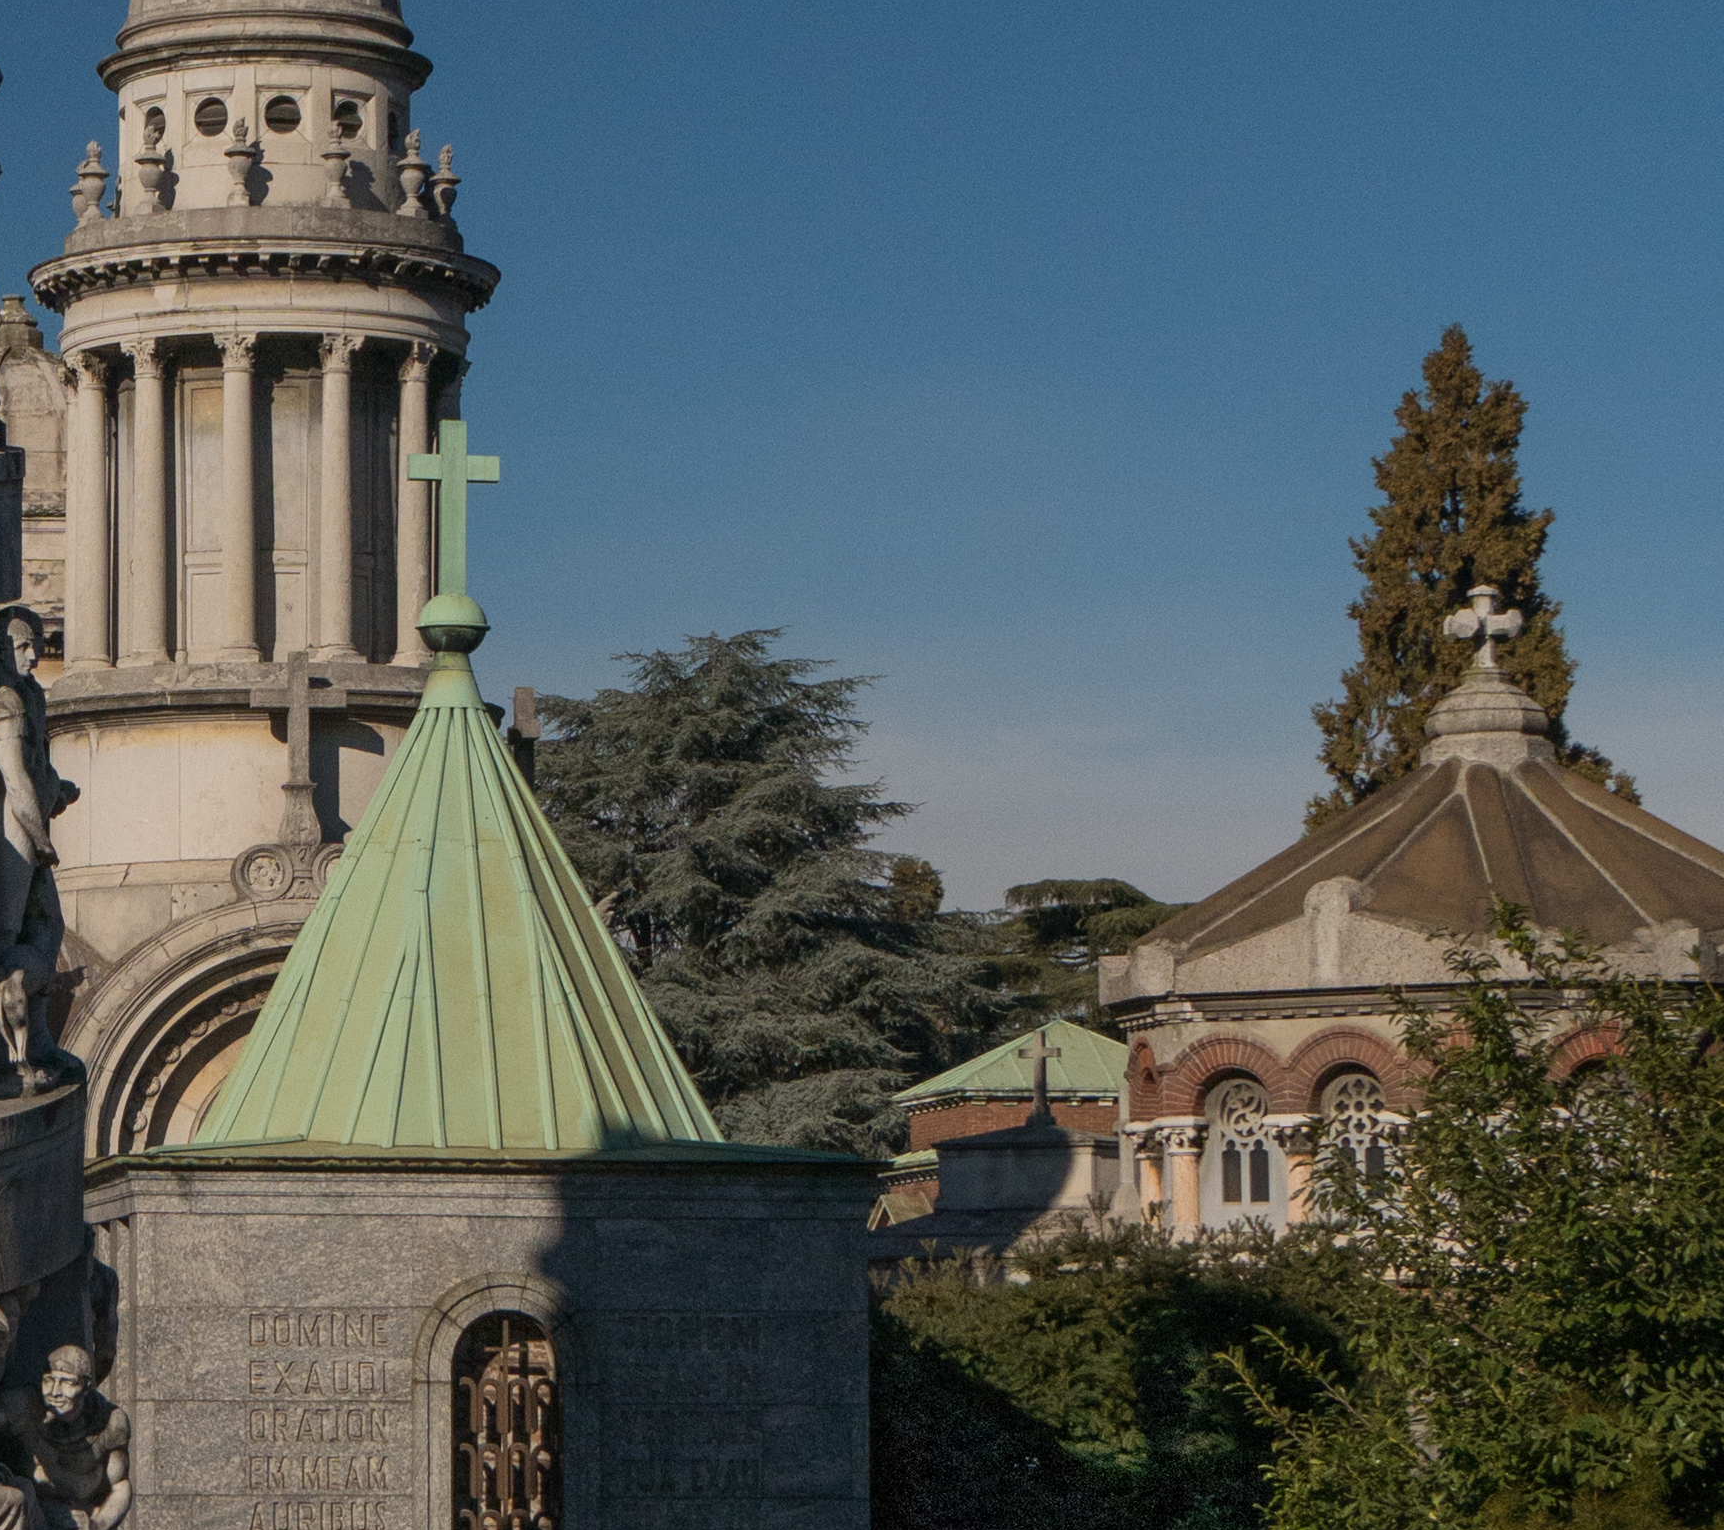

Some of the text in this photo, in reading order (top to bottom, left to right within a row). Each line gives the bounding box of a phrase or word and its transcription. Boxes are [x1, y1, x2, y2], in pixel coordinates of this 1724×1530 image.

[248, 1313, 388, 1348] DOMINE
[248, 1360, 388, 1395] EXAUDI
[248, 1408, 388, 1443] ORATION
[248, 1455, 388, 1489] EM MEAM
